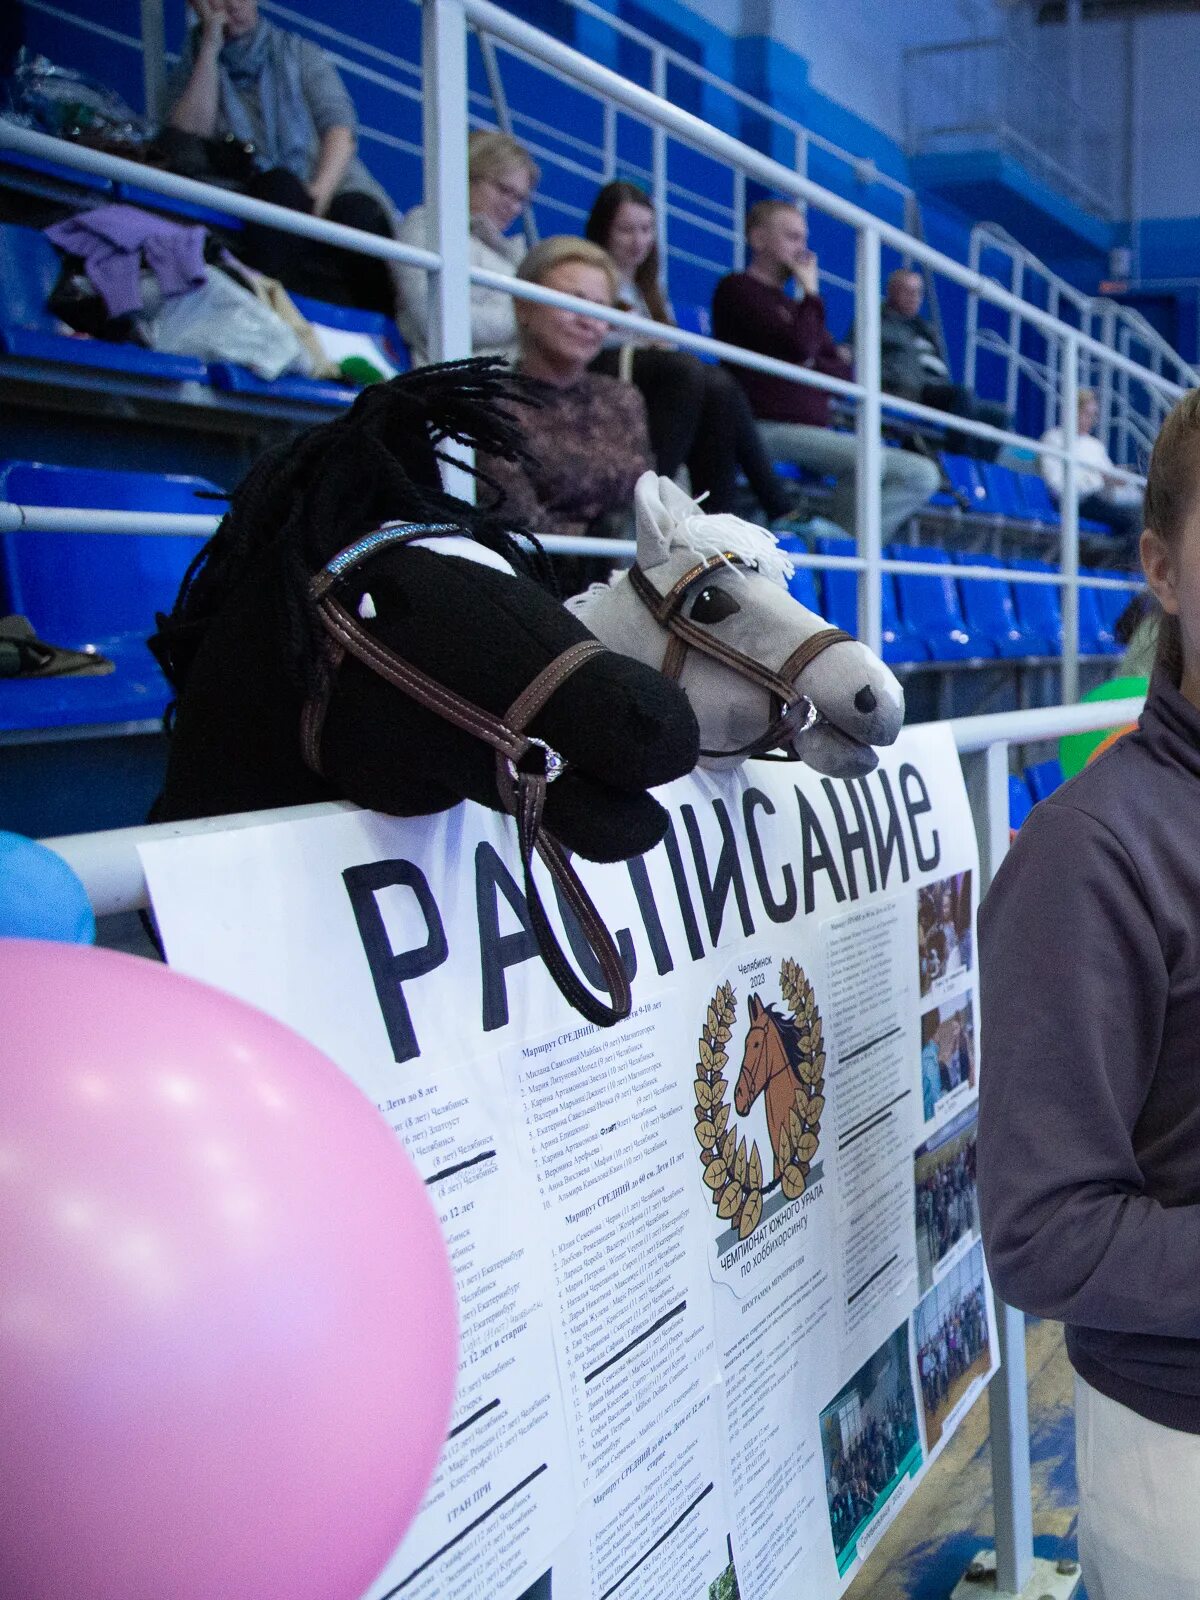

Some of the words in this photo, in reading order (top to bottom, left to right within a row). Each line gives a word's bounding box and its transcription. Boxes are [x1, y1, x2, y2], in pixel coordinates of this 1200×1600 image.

[738, 955, 772, 975] Челябинск
[750, 973, 766, 988] 2023
[521, 1040, 556, 1058] Маршрут
[557, 1025, 594, 1046] СРЕДНИЙ
[638, 1003, 652, 1015] 9-10
[652, 1001, 662, 1011] лет
[609, 1036, 621, 1048] лет)
[620, 1024, 656, 1044] Магнитогорск
[604, 1052, 616, 1065] лет)
[615, 1043, 643, 1058] Челябинск
[530, 1094, 554, 1109] Карина
[616, 1060, 629, 1073] лет)
[628, 1051, 655, 1067] Челябинск
[616, 1075, 628, 1087] лет)
[627, 1061, 662, 1082] Магнитогорск
[386, 1097, 407, 1111] Дети
[425, 1085, 438, 1096] лет
[652, 1081, 678, 1097] Челябинск
[414, 1112, 431, 1125] лет)
[430, 1097, 470, 1117] Челябинск
[536, 1117, 568, 1137] Екатерина
[621, 1087, 632, 1099] лет)
[631, 1077, 658, 1093] Челябинск
[631, 1104, 657, 1121] Челябинск
[412, 1129, 428, 1143] лет)
[428, 1116, 460, 1136] Златоуст
[544, 1160, 573, 1179] Вероника
[659, 1105, 683, 1120] Челябинск
[622, 1143, 634, 1155] лет)
[633, 1130, 659, 1148] Челябинск
[415, 1135, 456, 1156] Челябинск
[442, 1149, 458, 1163] лет)
[457, 1135, 494, 1155] Челябинск
[643, 1139, 668, 1156] Челябинск
[447, 1182, 463, 1195] лет)
[464, 1165, 498, 1185] Челябинск
[565, 1203, 596, 1224] Маршрут
[597, 1181, 631, 1207] СРЕДНИЙ
[656, 1161, 669, 1175] Дети
[675, 1152, 685, 1162] лет
[461, 1201, 474, 1214] лет
[720, 1227, 768, 1272] ЧЕМПИОНАТ
[768, 1202, 800, 1235] ЮЖНОГО
[800, 1184, 824, 1210] УРАЛА
[481, 1248, 524, 1278] Екатеринбург
[460, 1280, 497, 1304] Челябинск
[476, 1282, 520, 1313] Екатеринбург
[472, 1300, 516, 1332] Екатеринбург
[480, 1343, 492, 1358] лет
[500, 1321, 527, 1344] старше
[481, 1356, 516, 1382] Челябинск
[520, 1393, 551, 1418] Челябинск
[517, 1410, 549, 1436] Челябинск
[447, 1497, 472, 1523] ГРАН
[472, 1481, 492, 1503] ПРИ
[500, 1494, 531, 1521] Челябинск
[505, 1503, 538, 1532] Челябинск
[497, 1525, 531, 1555] Челябинск
